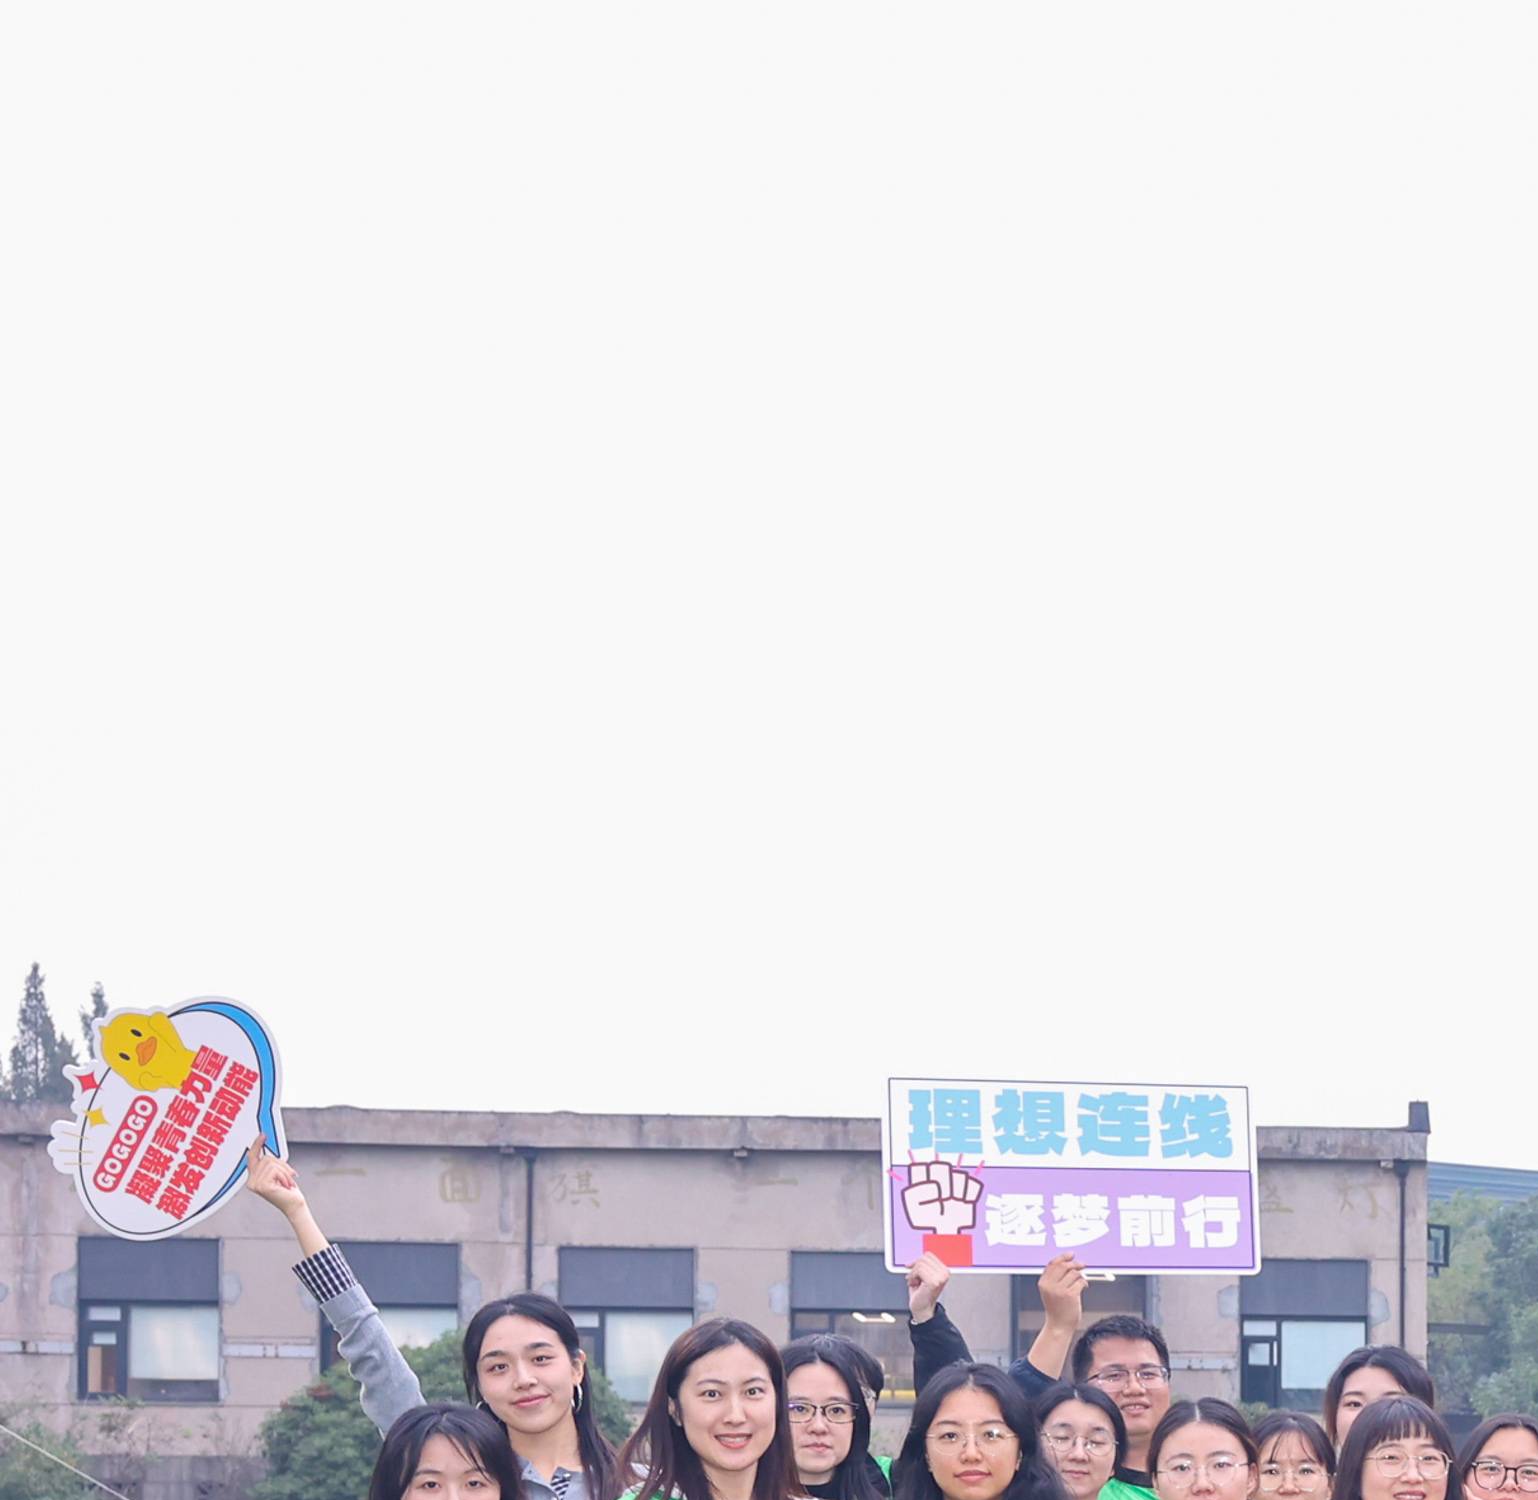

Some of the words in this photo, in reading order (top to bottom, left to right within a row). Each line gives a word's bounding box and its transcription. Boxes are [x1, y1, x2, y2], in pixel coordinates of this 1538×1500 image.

[96, 1099, 154, 1188] GOGOGO
[125, 1045, 228, 1205] 凝聚青春力量
[156, 1061, 259, 1221] 激发创新动能
[907, 1088, 1234, 1159] 理想连线
[984, 1193, 1241, 1248] 逐梦前行
